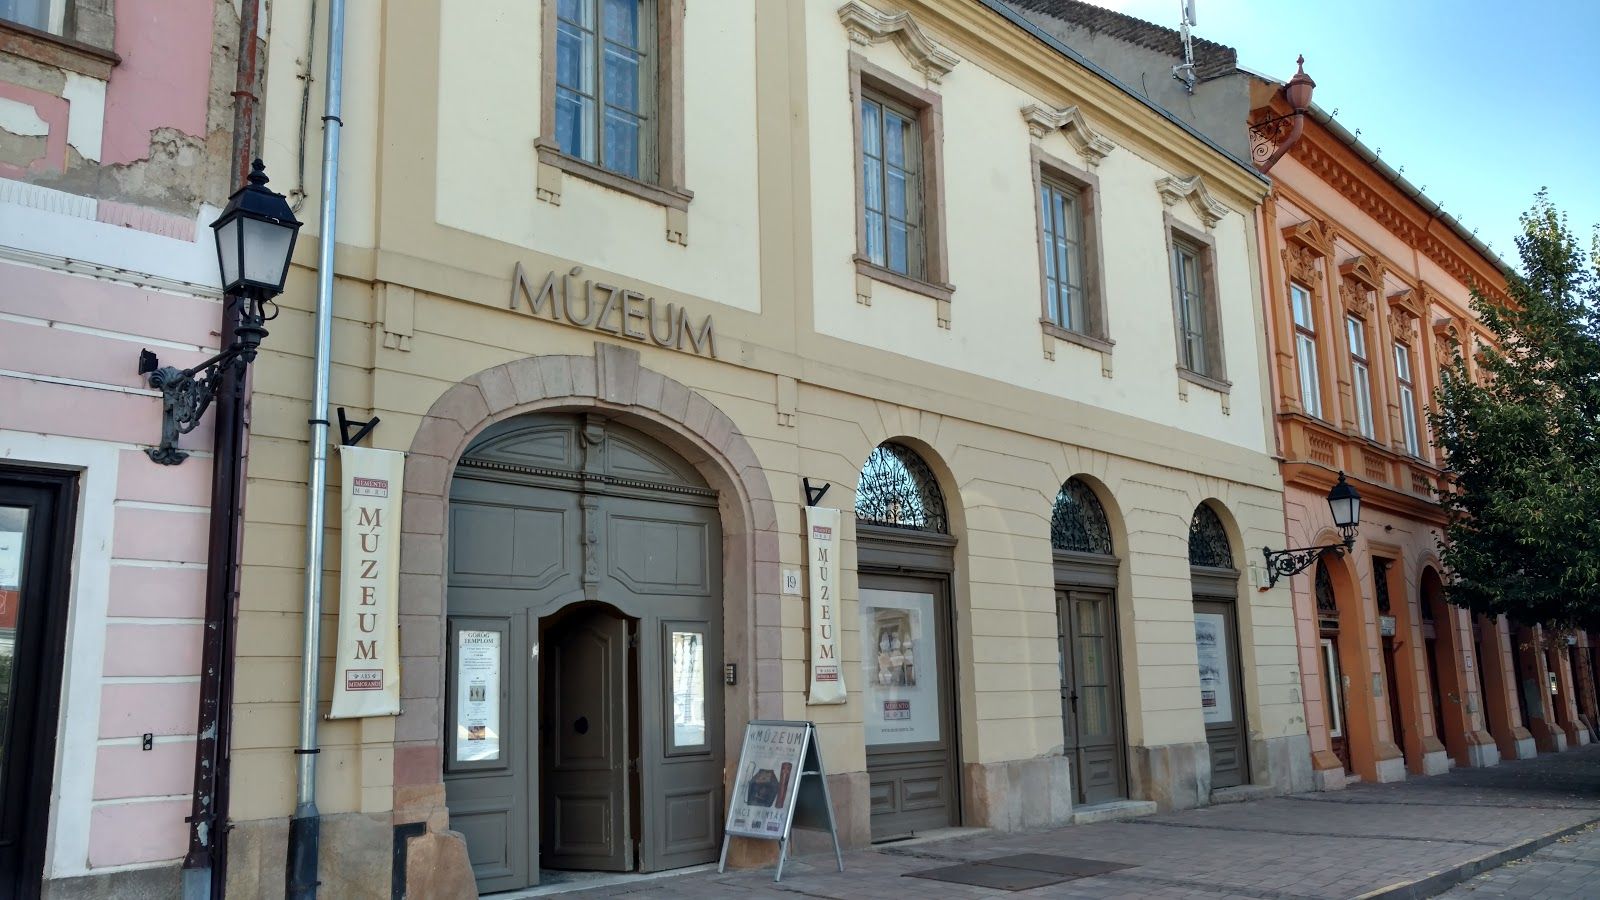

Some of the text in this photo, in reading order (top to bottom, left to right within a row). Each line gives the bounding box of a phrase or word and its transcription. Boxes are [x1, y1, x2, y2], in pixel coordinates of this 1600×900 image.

[509, 260, 718, 359] MÚZEUM
[355, 479, 387, 488] MEMENTO
[353, 506, 383, 660] MÚZEUM
[787, 575, 797, 589] 19
[818, 547, 834, 659] MÚZEUM
